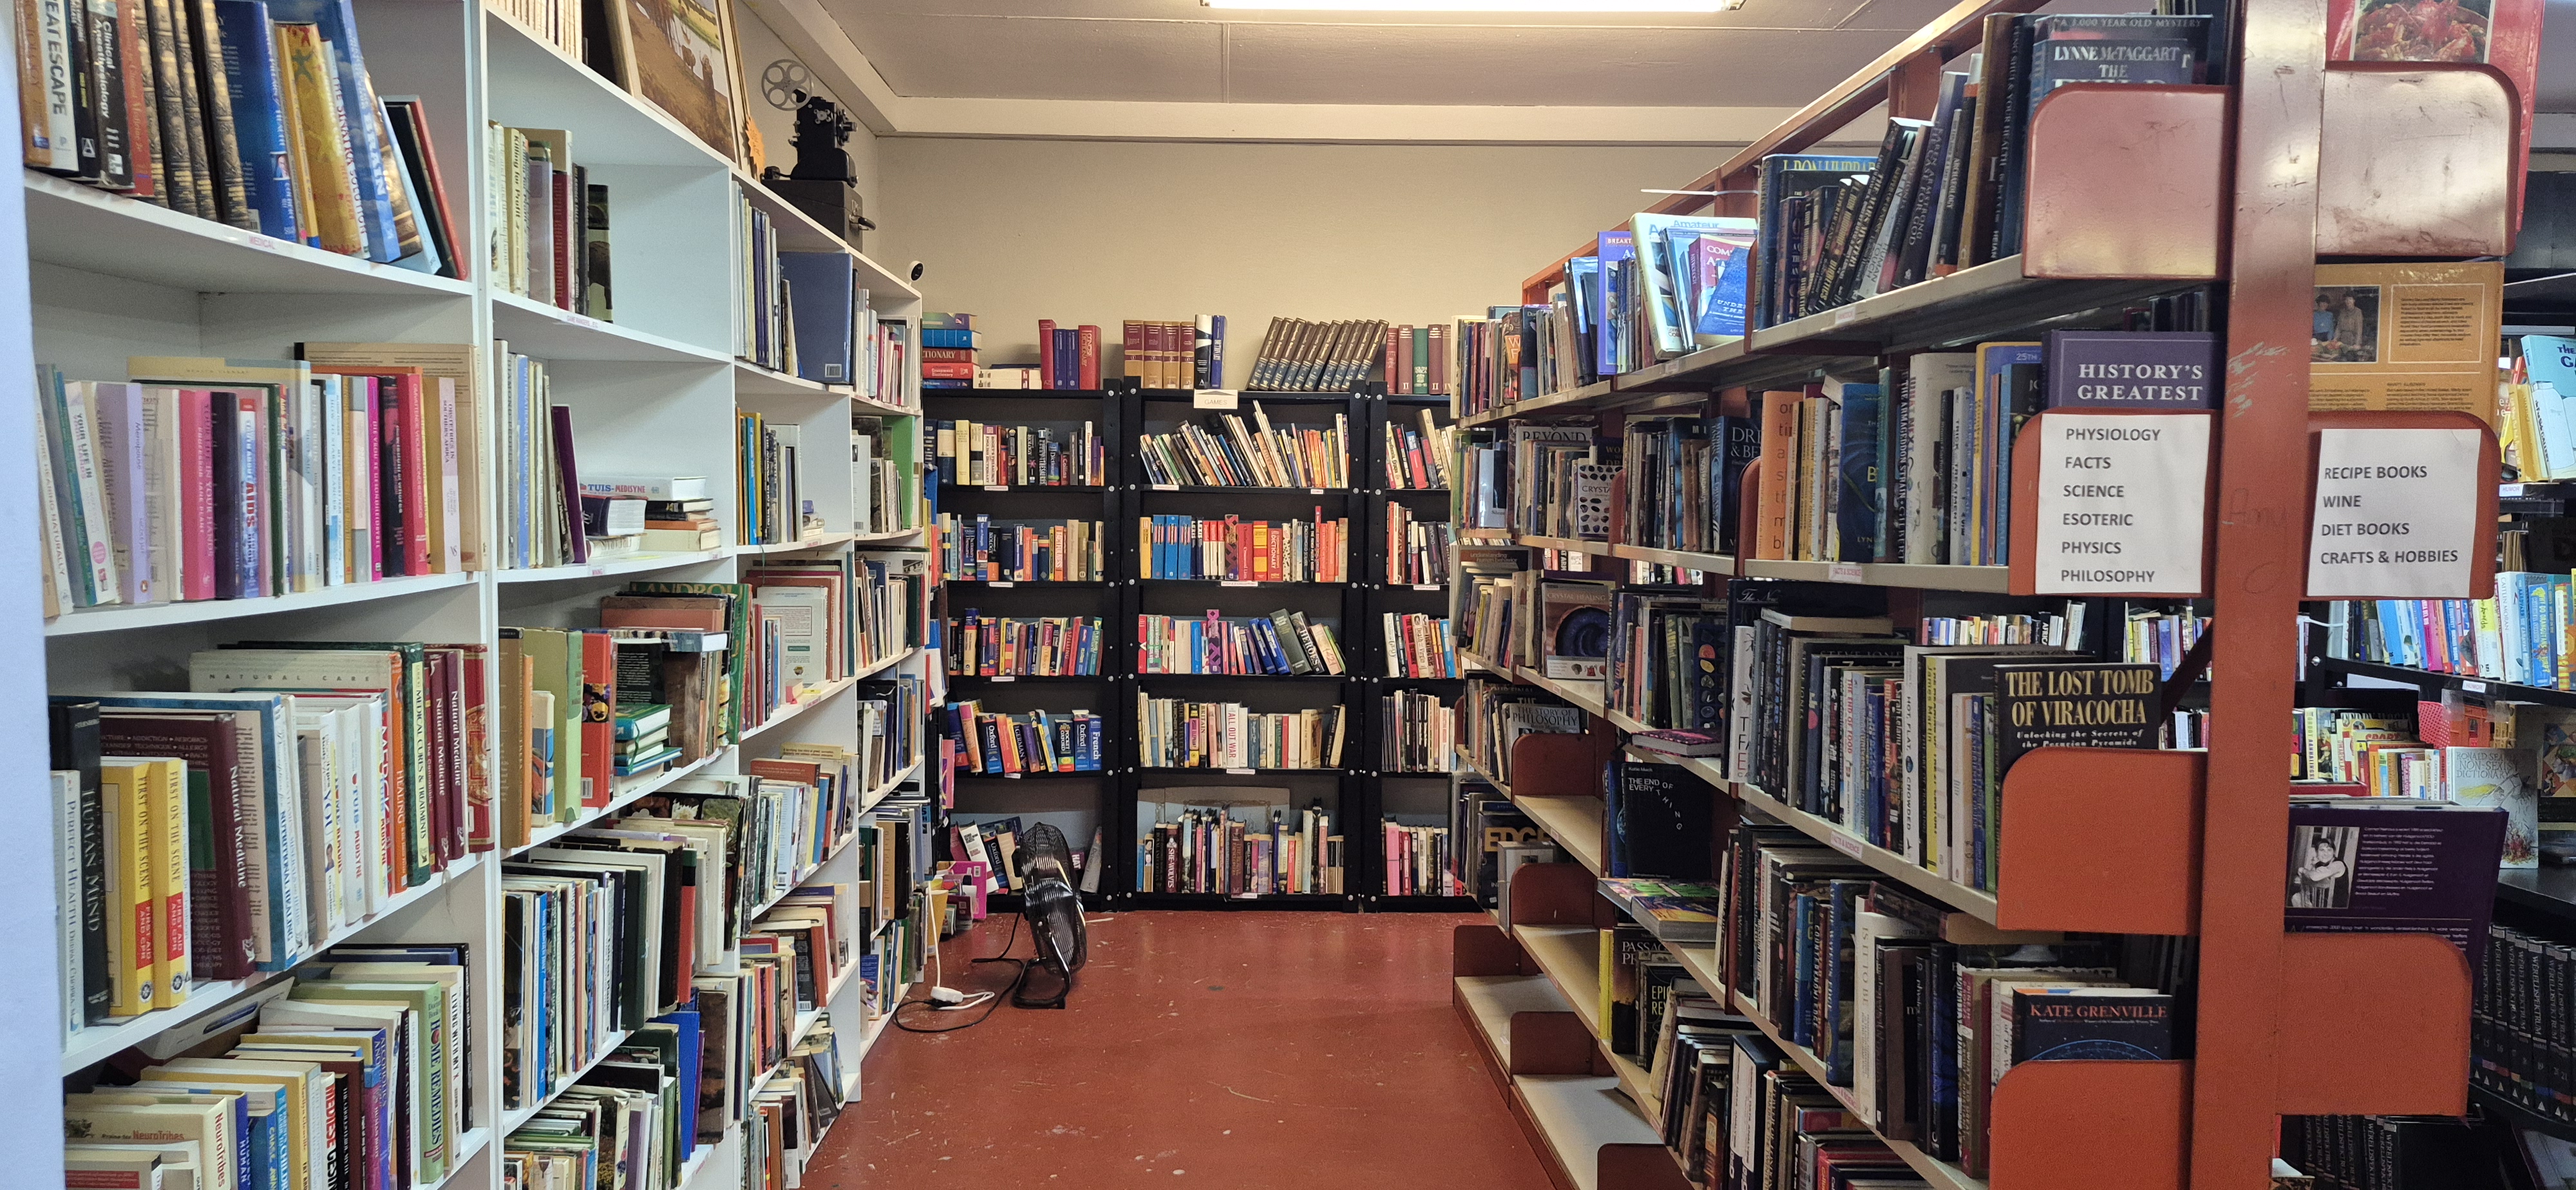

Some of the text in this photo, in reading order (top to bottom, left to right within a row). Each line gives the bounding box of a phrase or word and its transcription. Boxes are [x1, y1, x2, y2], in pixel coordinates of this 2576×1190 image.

[102, 21, 116, 70] Clinical
[2054, 46, 2181, 61] LYNNE McTAGGART
[45, 0, 67, 115] EAT ESCAPE
[2099, 64, 2128, 78] THE
[332, 77, 367, 234] THE SINATRA SOLUTION
[1946, 158, 1960, 209] ARCHAEOLOGY
[1674, 220, 1720, 229] Amateur
[1849, 174, 1884, 268] THE MARS MYSTERY
[249, 235, 276, 250] MEDICAL
[1866, 242, 1882, 279] TOUCH
[1871, 243, 1889, 283] HUMAN
[1820, 260, 1838, 301] DIANETICS
[2077, 364, 2202, 379] HISTORY'S
[2077, 385, 2203, 401] GREATEST
[1522, 431, 1587, 442] BEYOND
[1900, 402, 1908, 463] ARMAGEDDON
[2066, 428, 2161, 442] PHYSIOLOGY
[2065, 457, 2111, 469] FACTS
[2324, 465, 2428, 480] RECIPE BOOKS
[587, 484, 646, 493] TUIS-MEDISYNE
[1899, 465, 1907, 498] STRAIN
[2063, 485, 2124, 498] SCIENCE
[2322, 495, 2362, 508] WINE
[2062, 513, 2134, 526] ESOTERIC
[2321, 522, 2410, 536] DIET BOOKS
[2061, 541, 2121, 554] PHYSICS
[2320, 549, 2458, 565] CRAFTS & HOBBIES
[2061, 569, 2155, 583] PHILOSOPHY
[1299, 628, 1319, 666] HEROES
[2005, 670, 2154, 697] THE LOST TOMB
[1512, 712, 1577, 726] PHILOSOPHY
[1535, 707, 1558, 716] STORY
[2011, 699, 2146, 727] OF VIRACOCHA
[1847, 716, 1853, 726] OF
[451, 690, 462, 786] Natural Medicine
[989, 725, 997, 748] Oxford
[1228, 727, 1236, 740] OUT
[2016, 731, 2066, 740] Unlocking
[2090, 730, 2127, 738] Secrets
[2132, 729, 2144, 738] of
[435, 697, 446, 797] Natural Medicine
[1014, 728, 1025, 758] GERMAN
[1093, 731, 1102, 760] French
[2457, 752, 2487, 762] RONALD
[2459, 760, 2519, 772] NON-SEXIST
[419, 775, 425, 783] &
[2456, 770, 2510, 780] DICTIONARY
[1643, 778, 1660, 786] END
[1662, 781, 1674, 790] OF
[396, 770, 406, 824] HEALING
[137, 777, 148, 890] FIRST ON THE SCENE
[169, 771, 181, 883] FIRST ON THE SCENE
[230, 765, 247, 889] Natural Medicine
[81, 789, 100, 932] HUMAN MIND
[991, 842, 1001, 865] Oxford
[1072, 854, 1082, 869] HAT
[279, 810, 295, 943] NUTRITIONAL HEALING
[1862, 927, 1870, 1006] IS IT TO BE
[2031, 1005, 2168, 1019] KATE GRENVILLE
[452, 1056, 459, 1072] MY
[430, 1069, 442, 1145] REMEDIES
[132, 1130, 185, 1140] NeuroTribes
[215, 1111, 227, 1187] NeuroTribes
[239, 1140, 249, 1183] HUMAN
